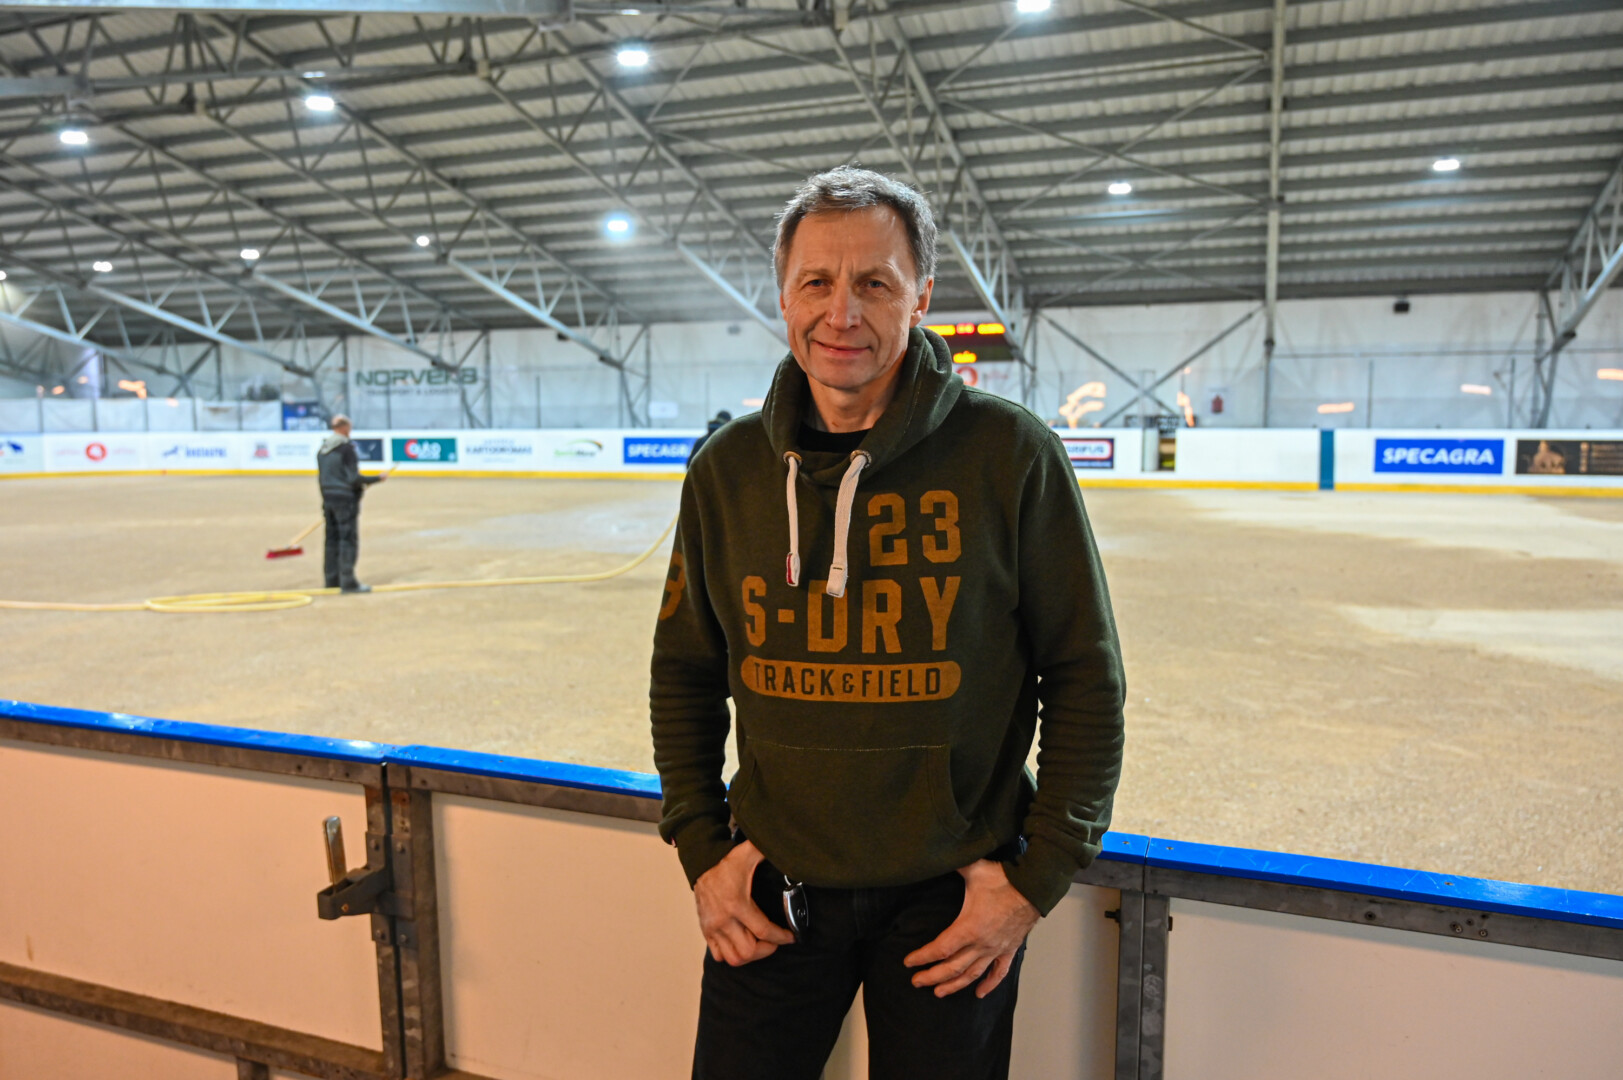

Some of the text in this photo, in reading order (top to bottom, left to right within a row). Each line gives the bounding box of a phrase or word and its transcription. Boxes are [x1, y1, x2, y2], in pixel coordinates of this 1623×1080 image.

[1382, 447, 1495, 466] SPECAGRA
[867, 489, 962, 567] 23
[741, 575, 961, 654] S-DRY
